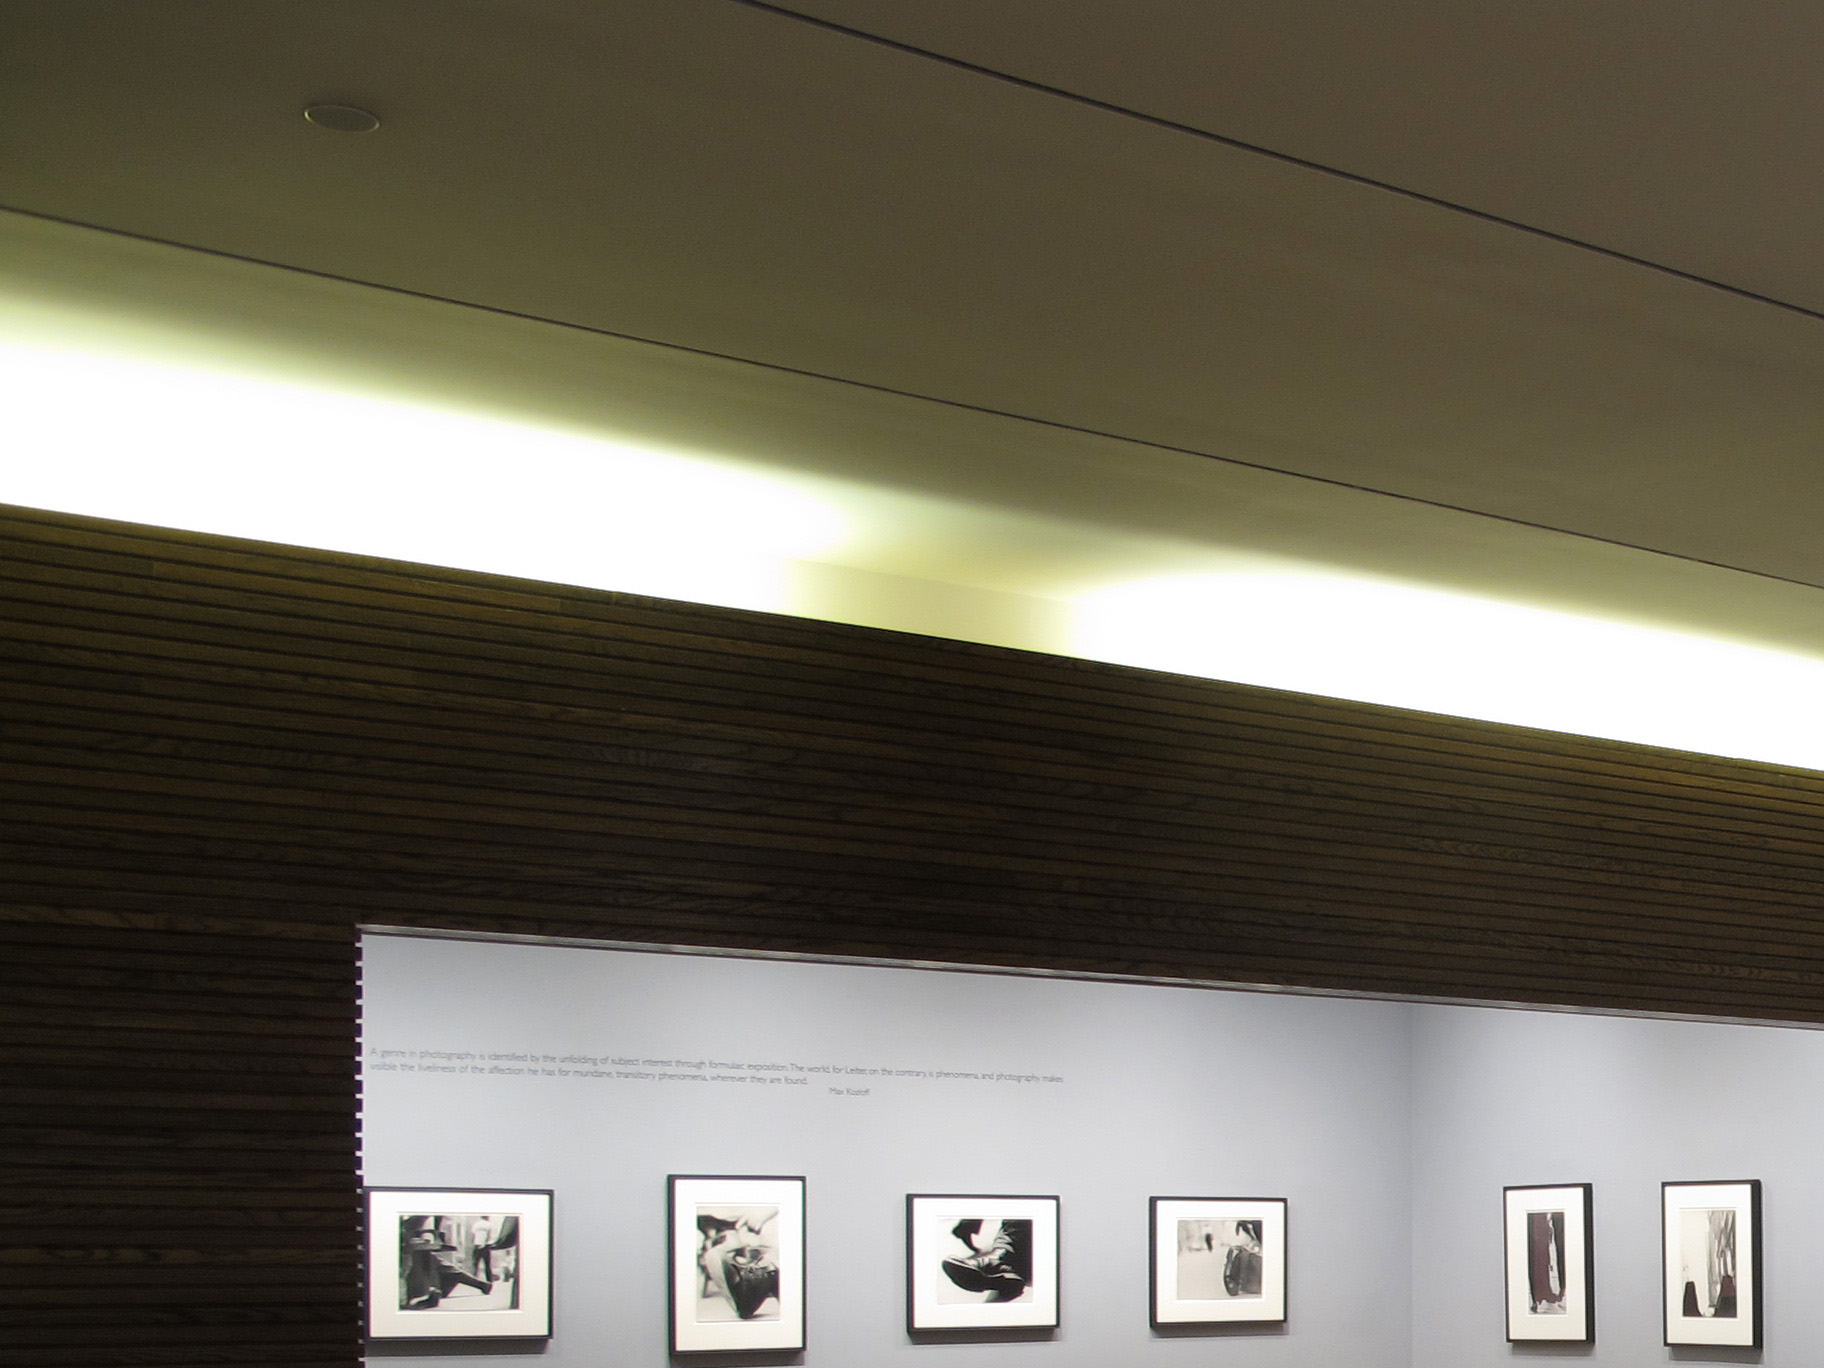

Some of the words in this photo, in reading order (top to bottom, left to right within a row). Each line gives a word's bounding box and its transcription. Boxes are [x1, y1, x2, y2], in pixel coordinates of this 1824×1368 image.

[400, 1063, 415, 1072] the
[460, 1064, 469, 1073] of
[470, 1065, 486, 1074] the
[488, 1065, 525, 1075] affection
[528, 1066, 539, 1076] he
[541, 1067, 556, 1077] has
[558, 1067, 572, 1077] for
[710, 1074, 747, 1083] wherever
[749, 1076, 767, 1085] they
[419, 1050, 476, 1062] photography
[488, 1052, 527, 1062] identified
[530, 1053, 540, 1064] by
[542, 1054, 557, 1063] the
[559, 1054, 598, 1067] unfolding
[599, 1056, 609, 1065] of
[611, 1057, 640, 1067] subject
[642, 1058, 673, 1067] interest
[675, 1059, 705, 1070] through
[790, 1062, 805, 1073] The
[832, 1064, 844, 1074] for
[869, 1068, 879, 1076] on
[881, 1067, 893, 1076] the
[981, 1071, 995, 1081] and
[996, 1072, 1040, 1084] photography
